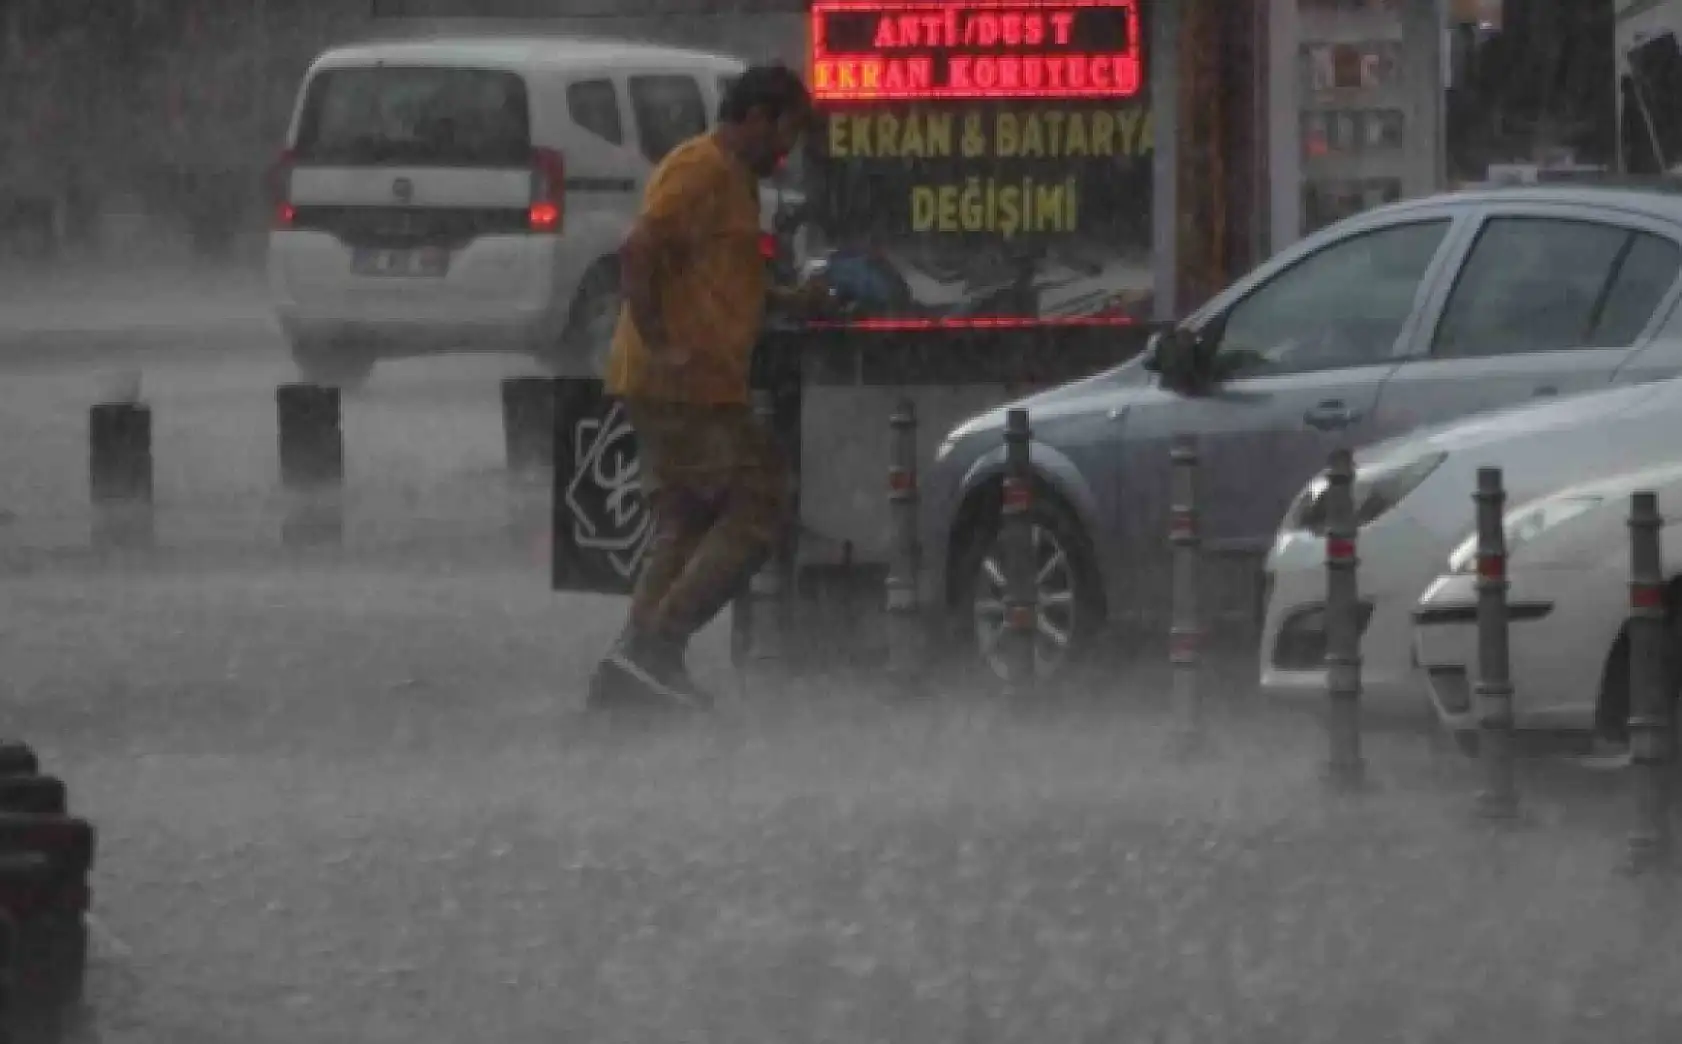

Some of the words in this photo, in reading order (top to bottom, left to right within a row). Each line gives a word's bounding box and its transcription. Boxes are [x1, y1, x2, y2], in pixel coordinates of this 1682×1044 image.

[814, 58, 932, 89] EKRAN
[829, 111, 953, 157] EKRAN
[962, 111, 985, 157] &
[911, 175, 1076, 241] DEĞİŞİMİ
